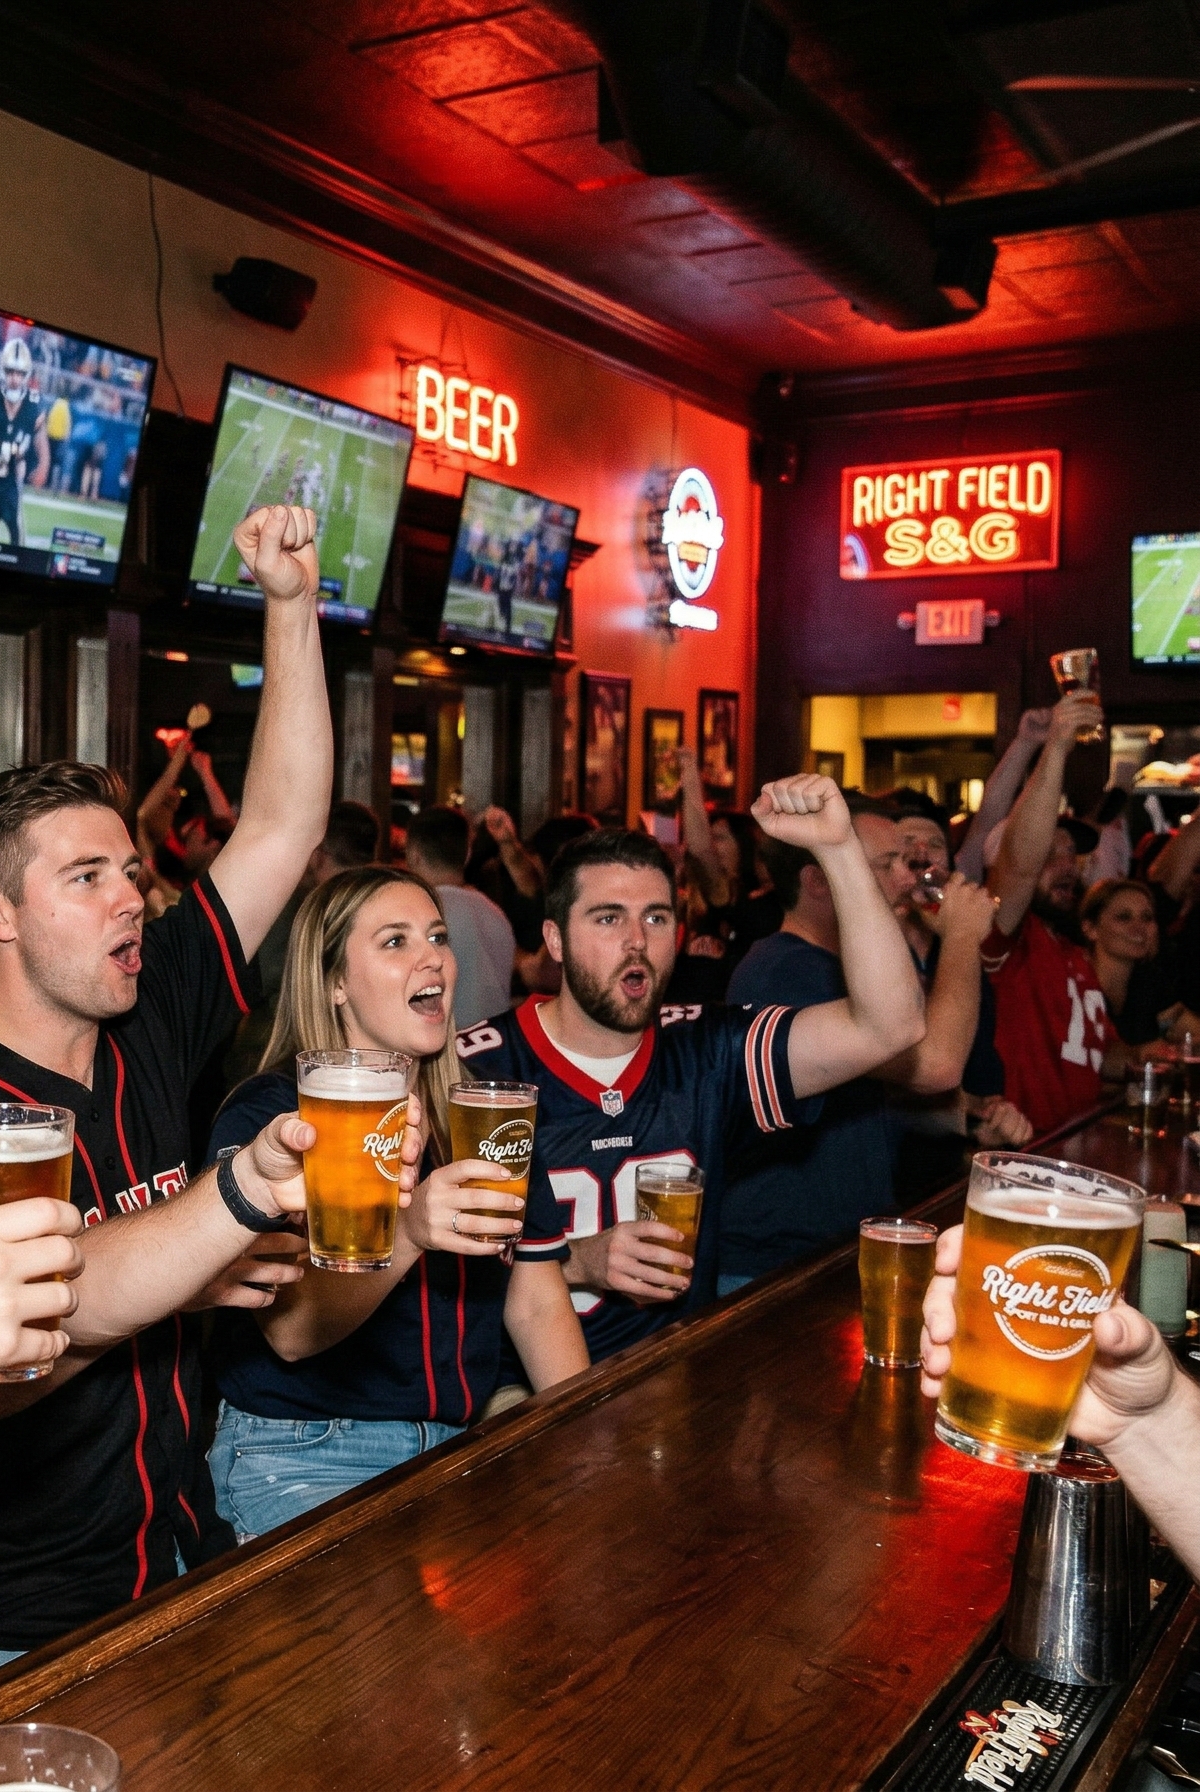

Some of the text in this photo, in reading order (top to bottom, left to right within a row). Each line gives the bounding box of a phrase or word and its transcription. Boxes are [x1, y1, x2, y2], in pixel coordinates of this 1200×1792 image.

[417, 365, 519, 467] BEER
[853, 461, 1051, 528] RIGHT FIELD
[883, 512, 1018, 567] S&G
[982, 1265, 1059, 1316] Right
[1058, 1285, 1117, 1315] Field
